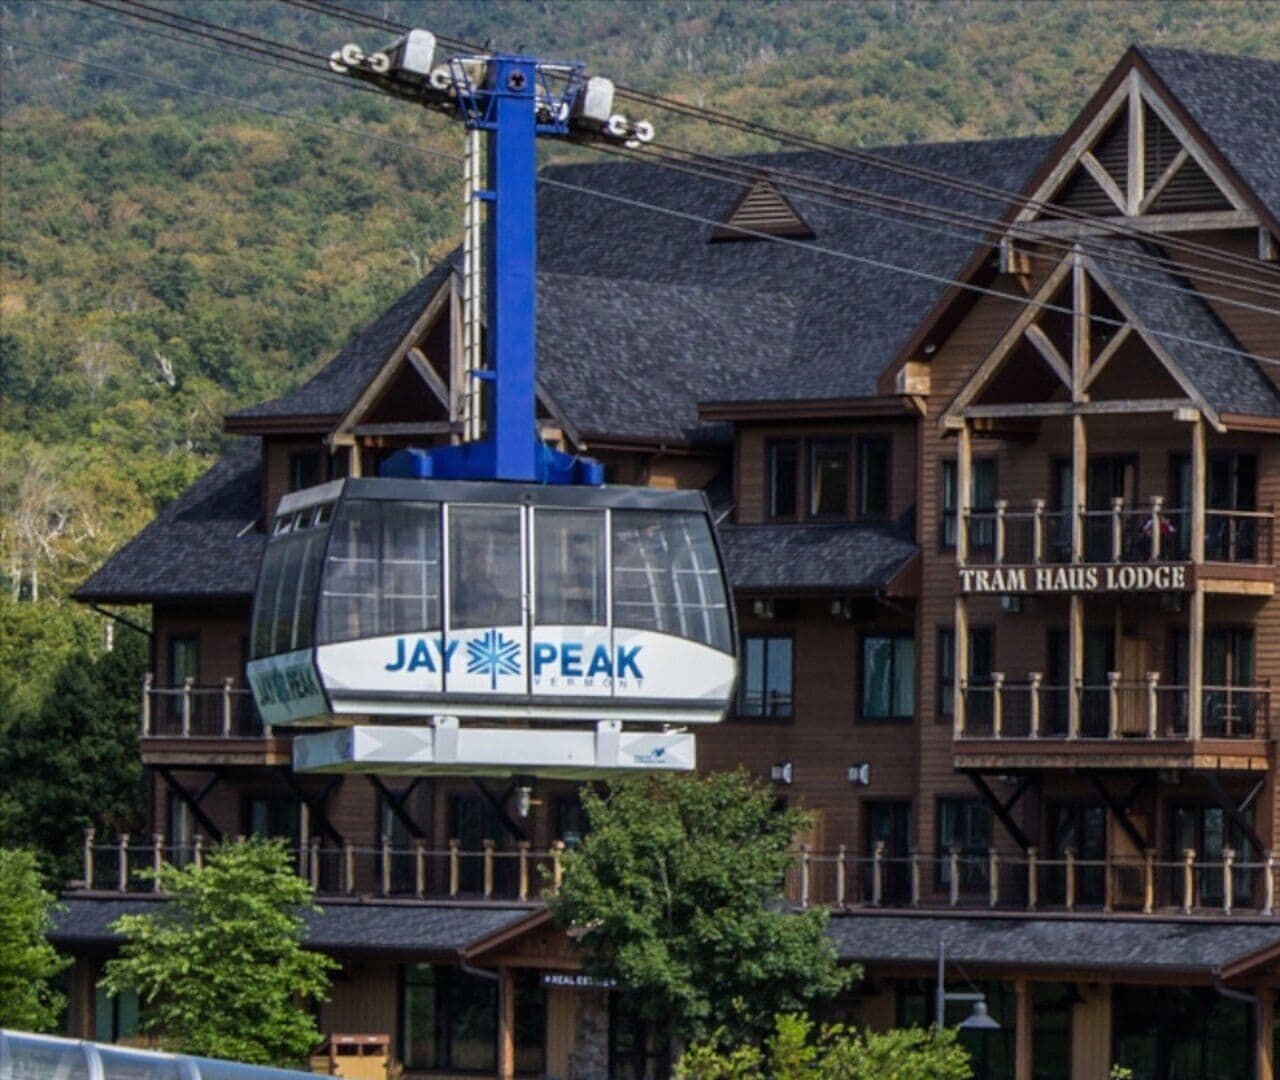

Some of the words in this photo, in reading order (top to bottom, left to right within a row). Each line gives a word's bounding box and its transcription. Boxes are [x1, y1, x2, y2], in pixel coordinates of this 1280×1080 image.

[959, 569, 1027, 591] TRAM
[1034, 567, 1098, 590] HAUS
[1106, 566, 1185, 589] LODGE
[384, 638, 460, 673] JAY
[533, 643, 644, 679] PEAK
[533, 676, 645, 689] VERMONT
